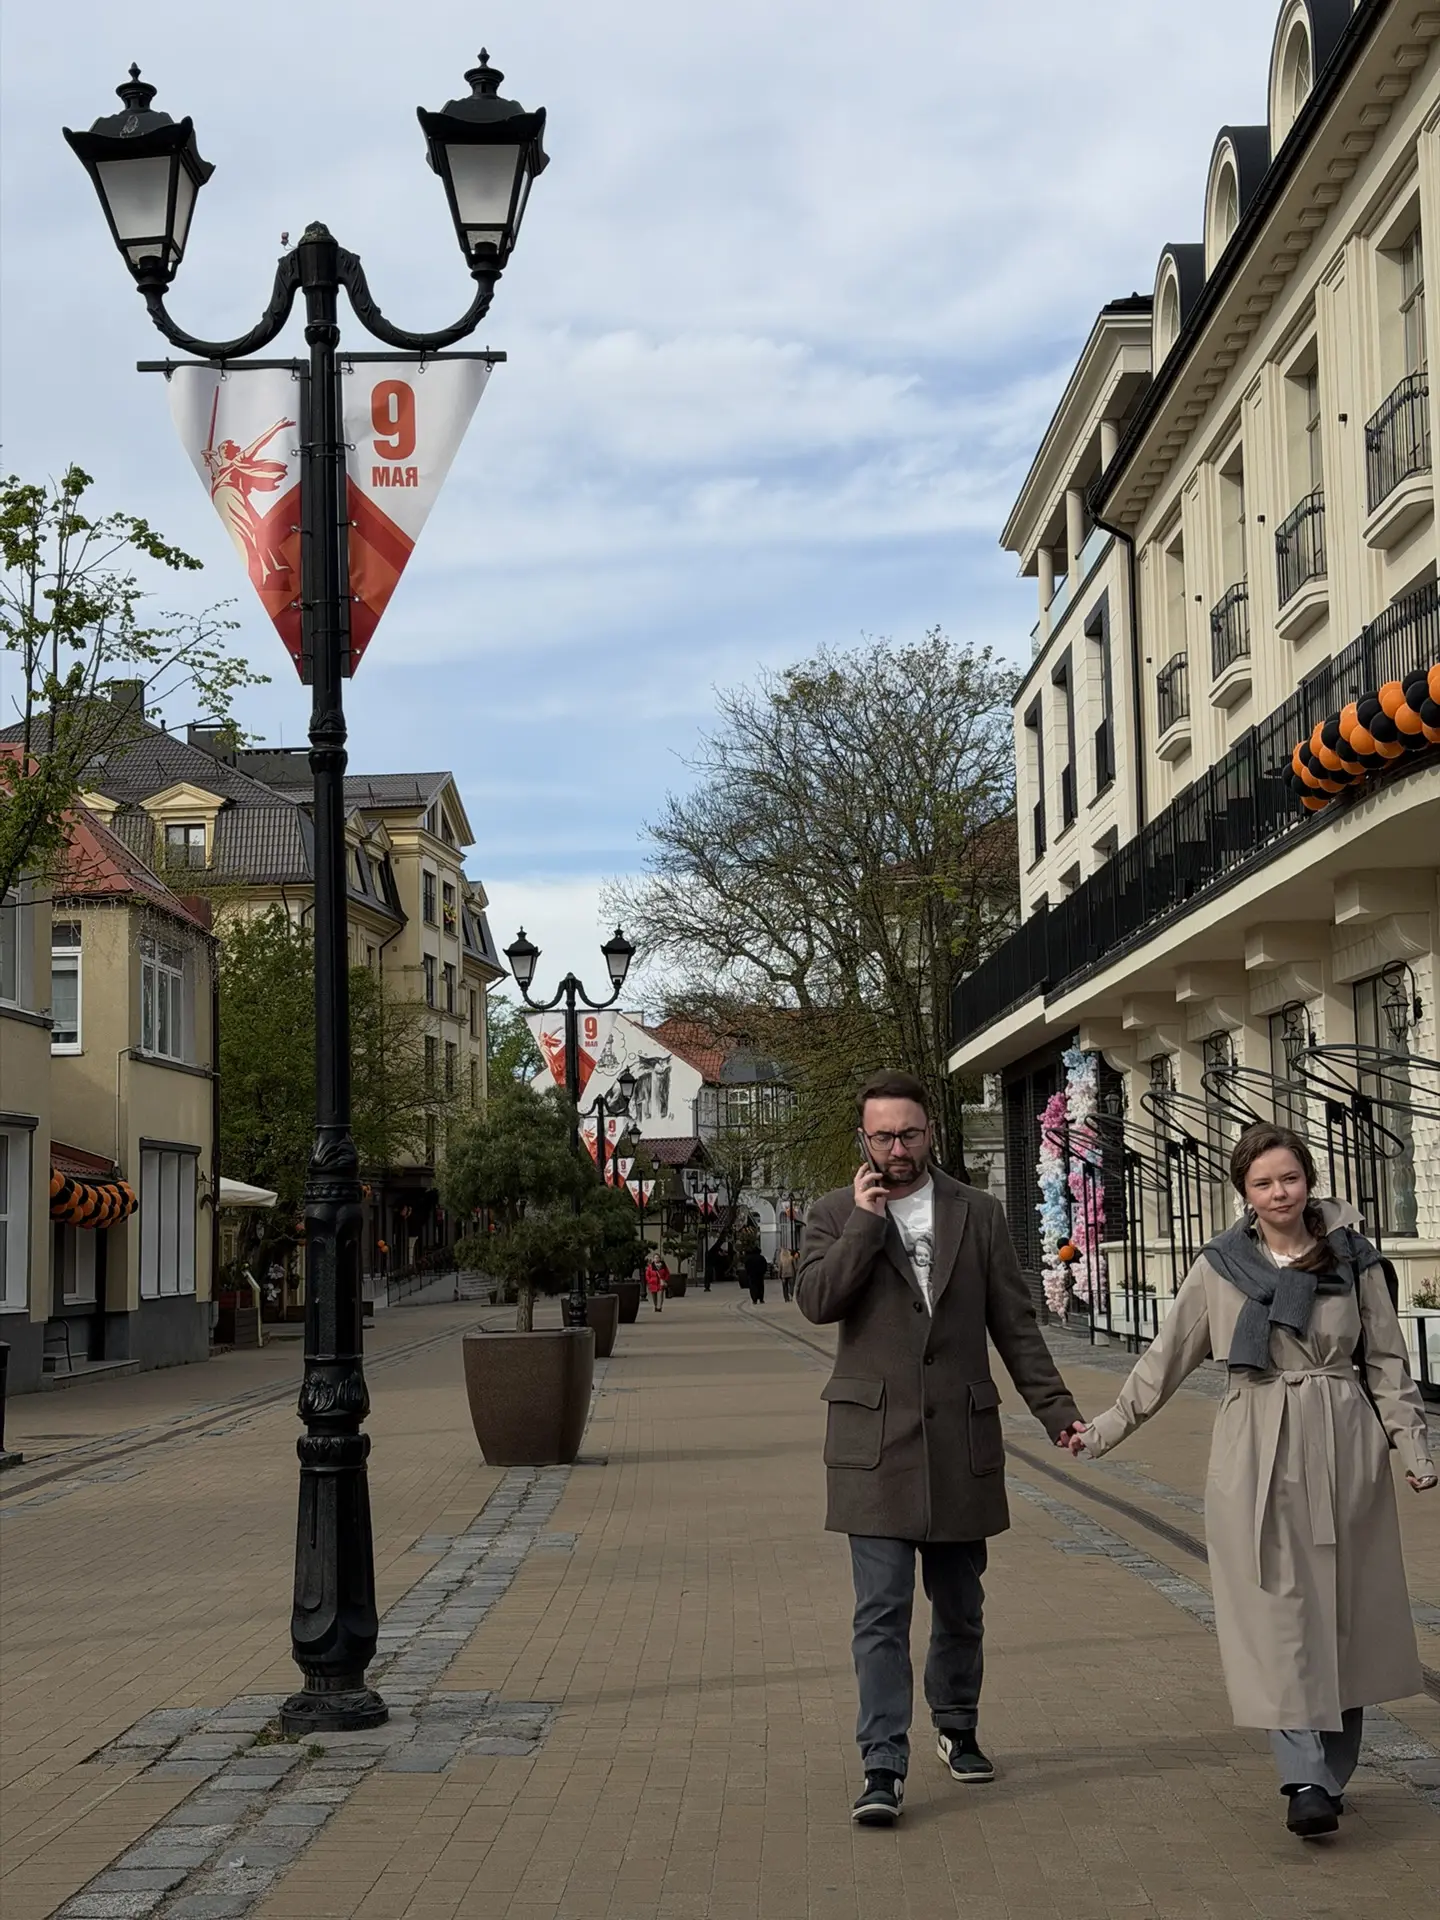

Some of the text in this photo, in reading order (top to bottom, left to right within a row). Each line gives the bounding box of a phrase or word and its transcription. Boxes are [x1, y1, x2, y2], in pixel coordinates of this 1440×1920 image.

[371, 379, 416, 461] 9
[372, 466, 418, 487] МАЯ
[584, 1016, 598, 1040] 9
[608, 1119, 616, 1133] 9
